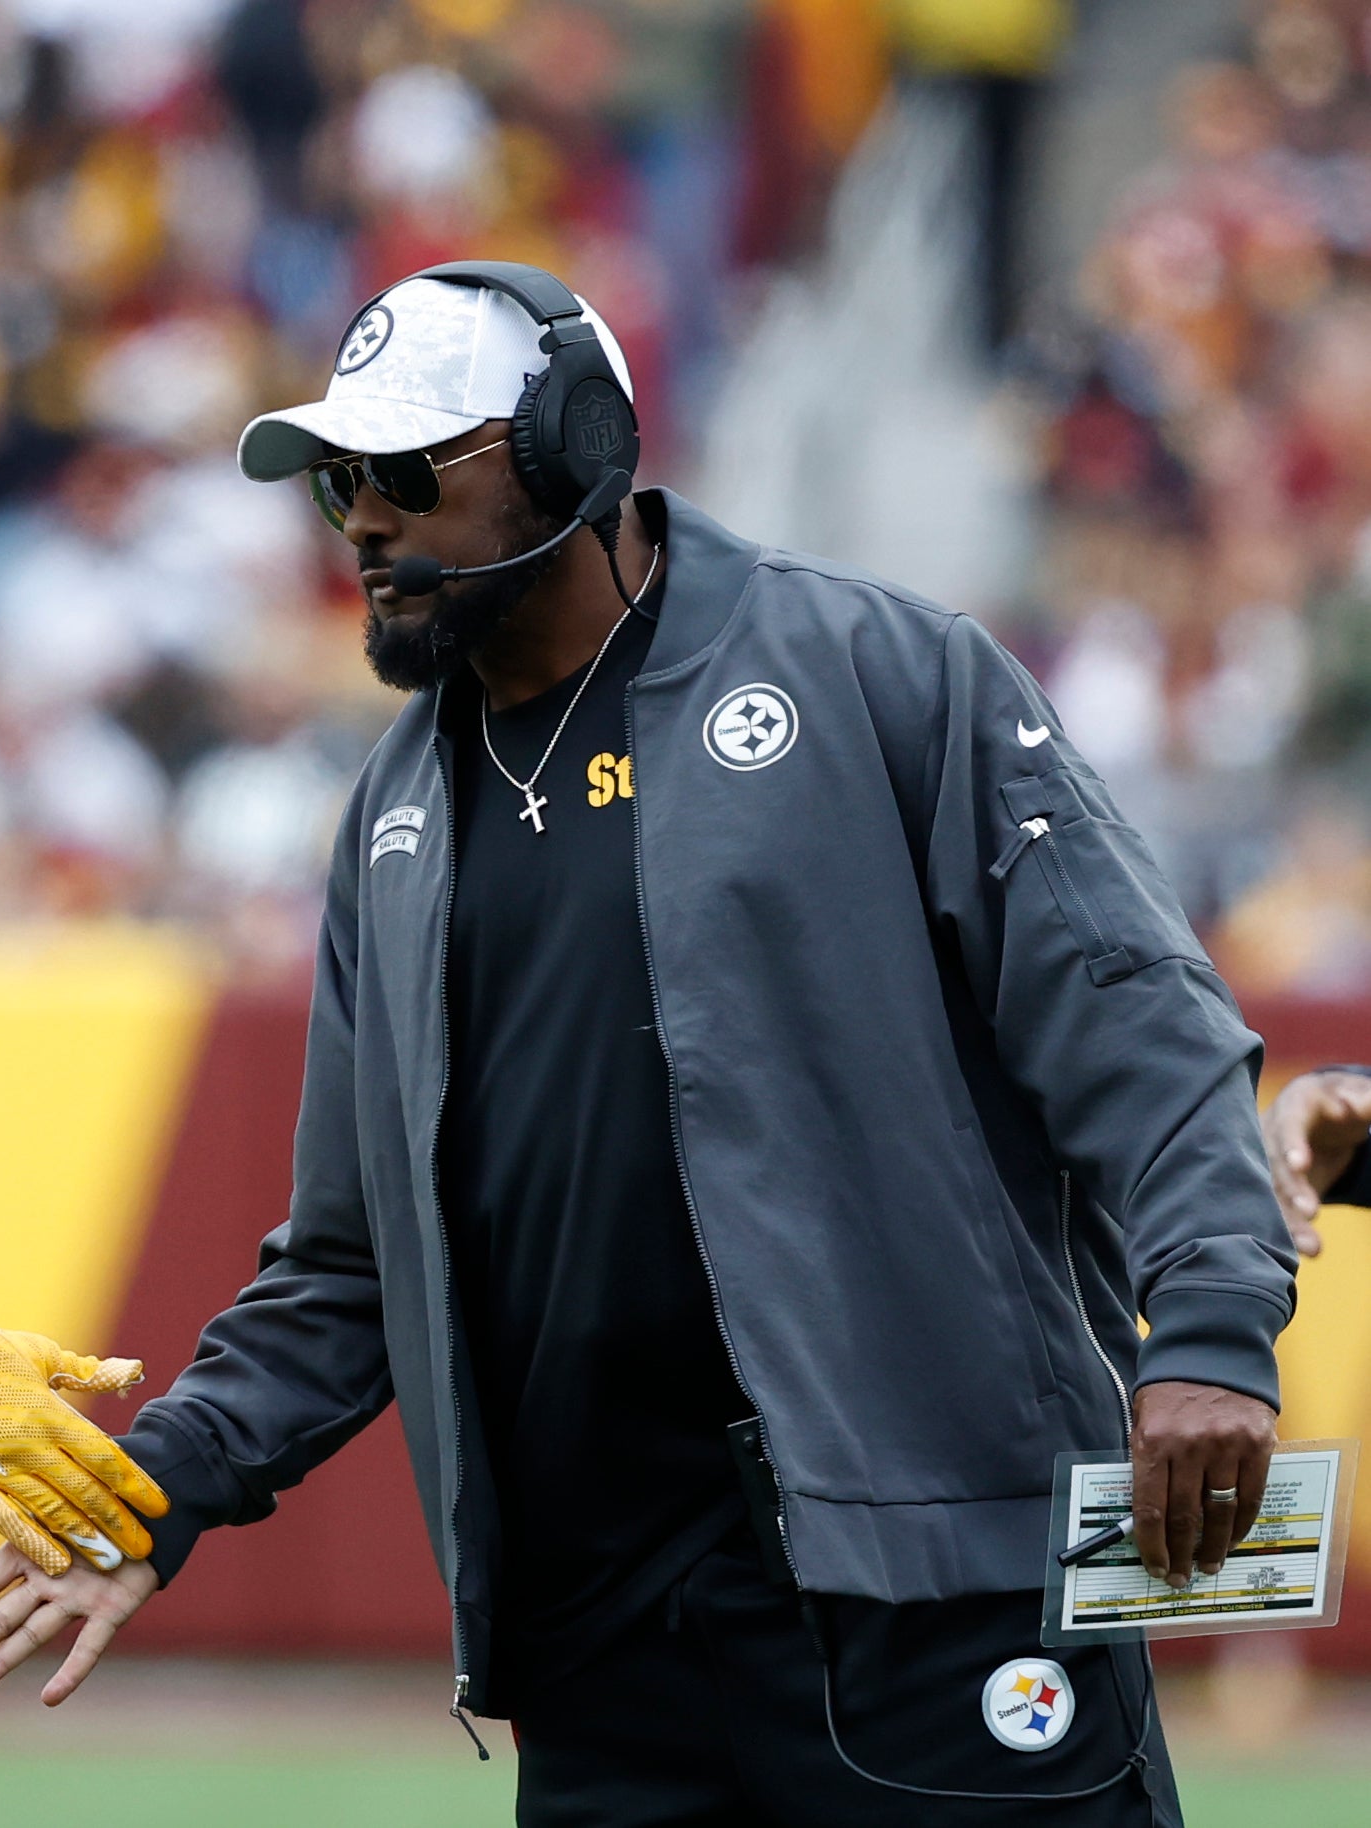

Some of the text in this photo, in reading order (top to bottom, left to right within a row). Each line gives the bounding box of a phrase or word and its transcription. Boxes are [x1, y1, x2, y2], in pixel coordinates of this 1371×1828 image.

[580, 420, 619, 454] NFL
[717, 725, 748, 737] Steelers
[997, 1702, 1029, 1720] Steelers
